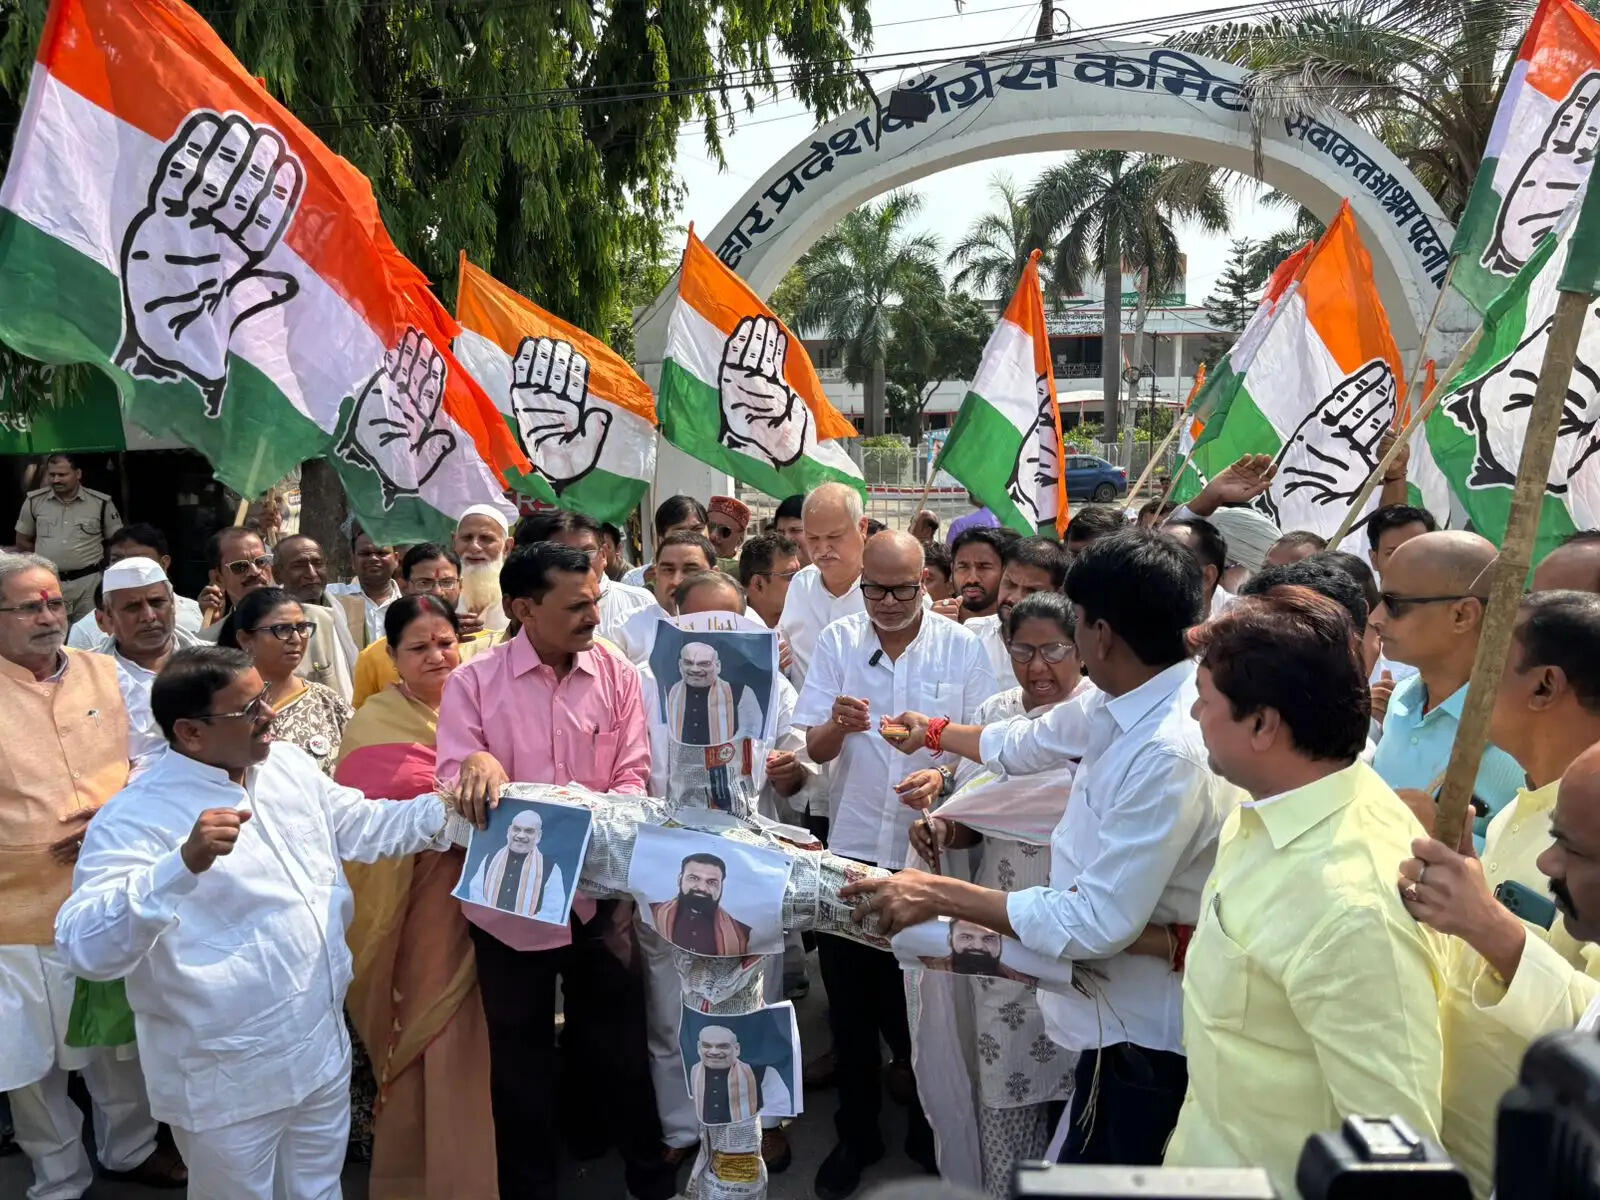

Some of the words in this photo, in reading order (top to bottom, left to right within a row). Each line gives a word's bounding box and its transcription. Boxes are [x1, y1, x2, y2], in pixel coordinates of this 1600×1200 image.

[715, 200, 774, 270] हार
[762, 116, 875, 214] प्रदेश
[1074, 50, 1249, 112] कमिट
